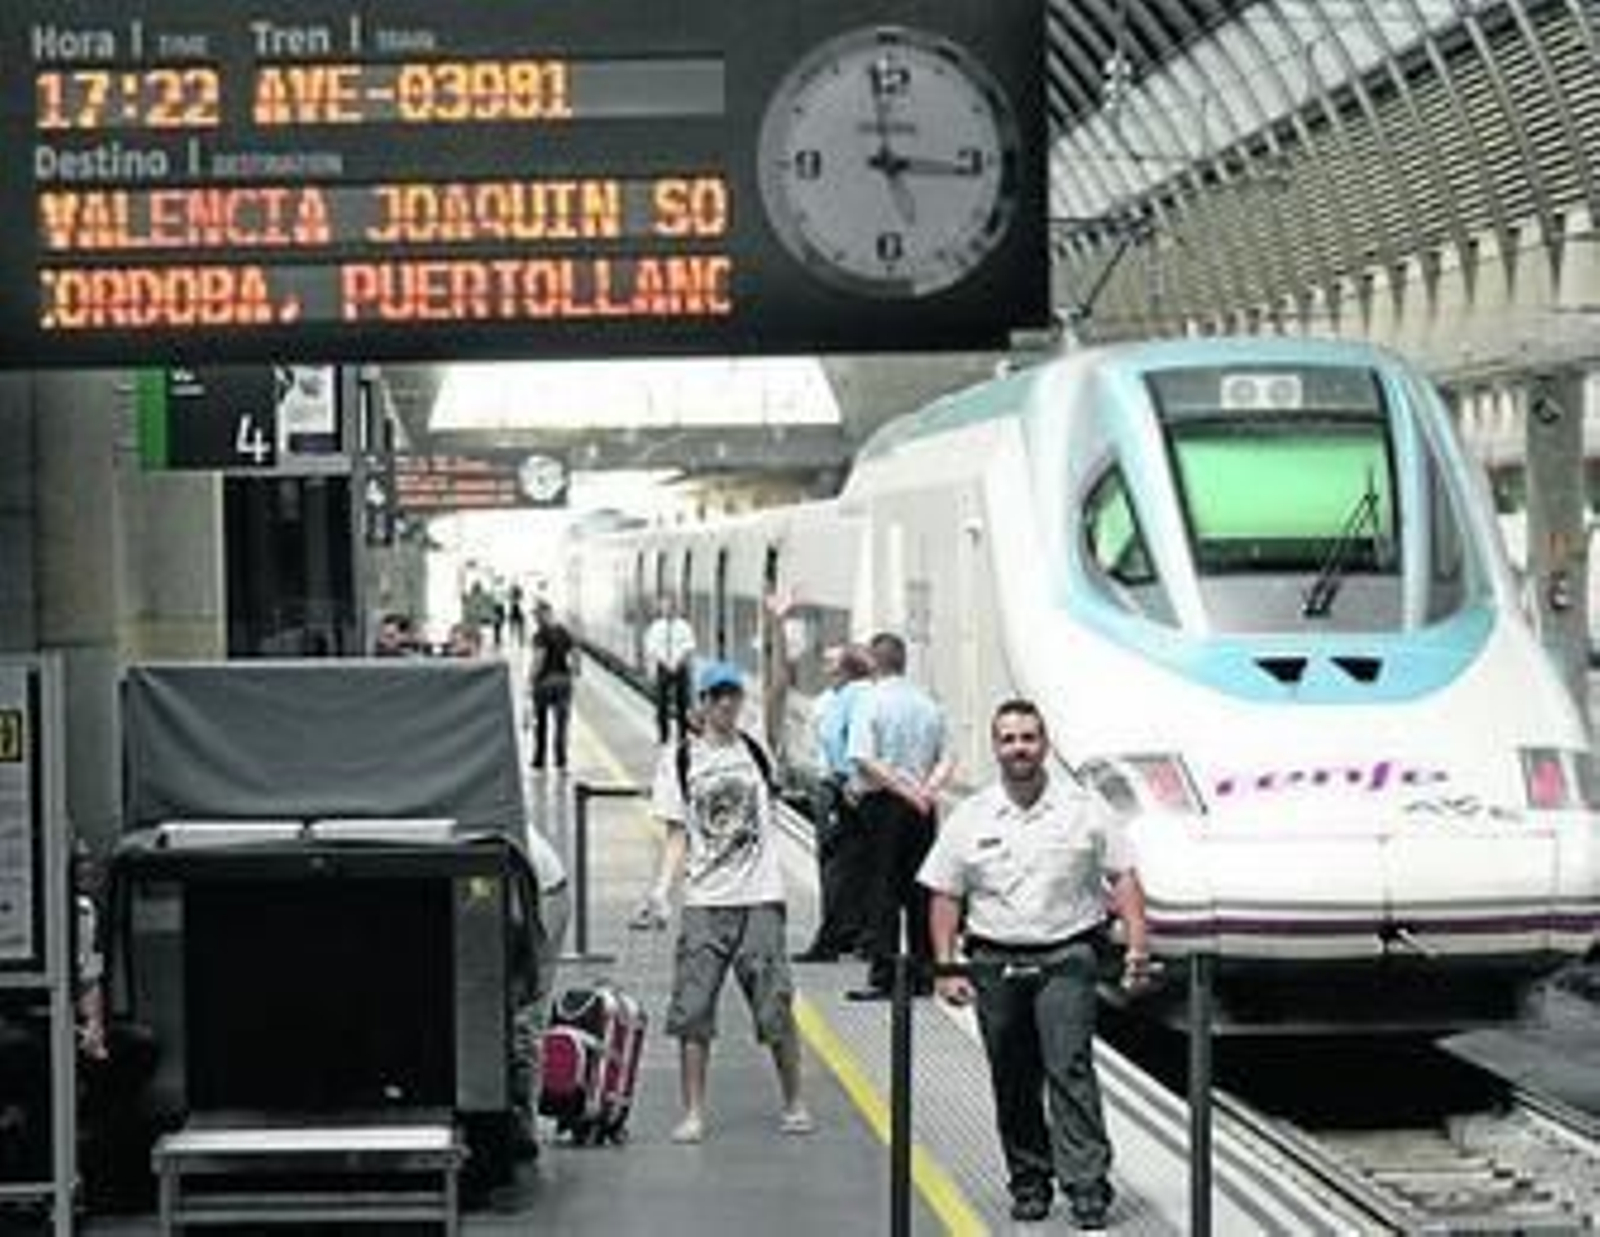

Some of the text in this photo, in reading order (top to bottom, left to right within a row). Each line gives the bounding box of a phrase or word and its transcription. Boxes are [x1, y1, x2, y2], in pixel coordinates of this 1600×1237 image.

[31, 23, 114, 58] Hora
[250, 20, 330, 55] Tren
[36, 69, 219, 128] 17:22
[35, 142, 168, 179] Destino
[41, 178, 727, 248] VALENCIA JOAQUIN SO
[236, 414, 271, 463] 4
